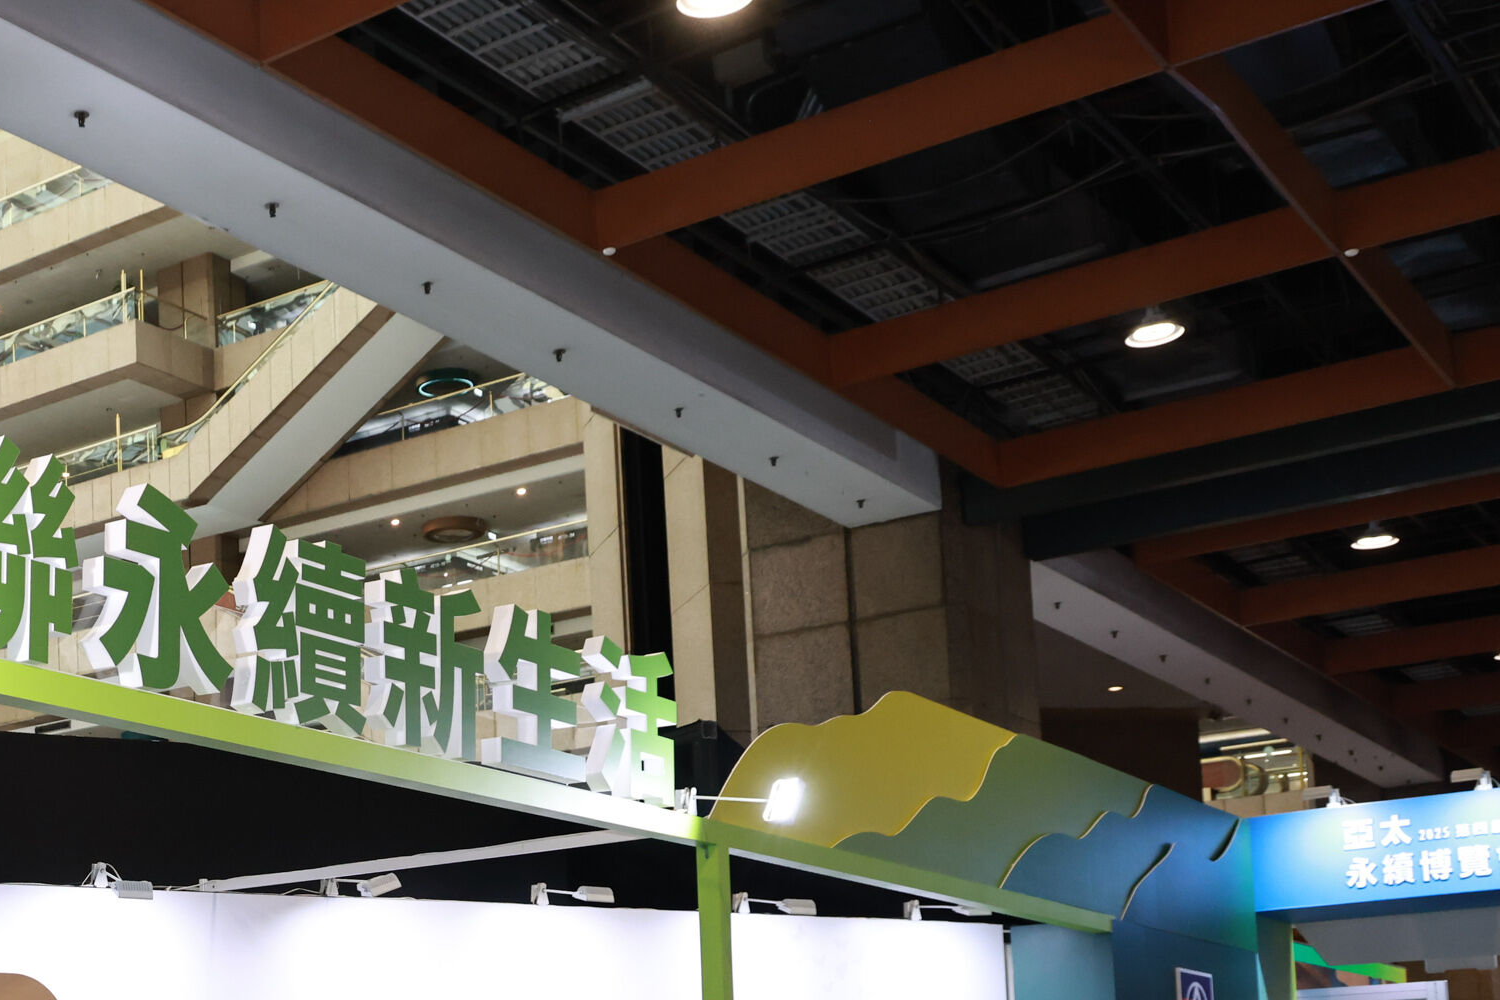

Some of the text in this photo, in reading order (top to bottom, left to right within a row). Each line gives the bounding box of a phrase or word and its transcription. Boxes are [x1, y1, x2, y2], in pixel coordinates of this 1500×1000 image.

[1341, 814, 1412, 850] 亞太
[1418, 826, 1450, 841] 2025
[1346, 844, 1500, 889] 永續博覽
